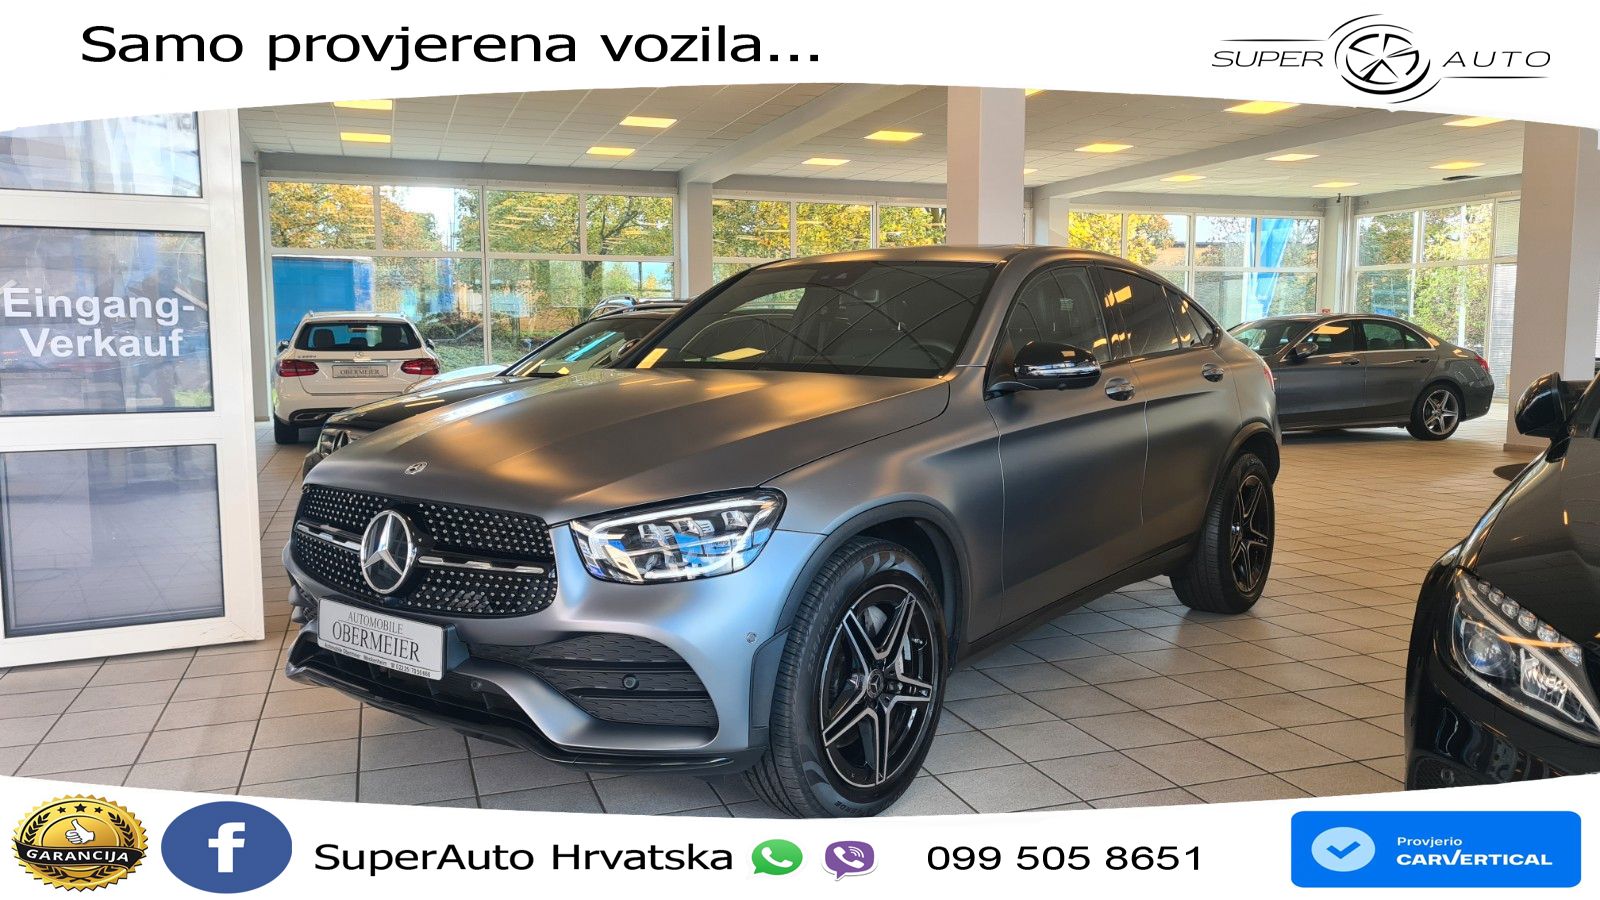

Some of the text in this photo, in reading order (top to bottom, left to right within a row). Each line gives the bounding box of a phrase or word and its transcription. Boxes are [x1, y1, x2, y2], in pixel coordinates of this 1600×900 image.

[4, 287, 195, 327] Eingang-
[19, 328, 184, 358] Verkauf
[348, 611, 403, 635] AUTOMOBILE
[332, 621, 420, 662] OBERMEIER
